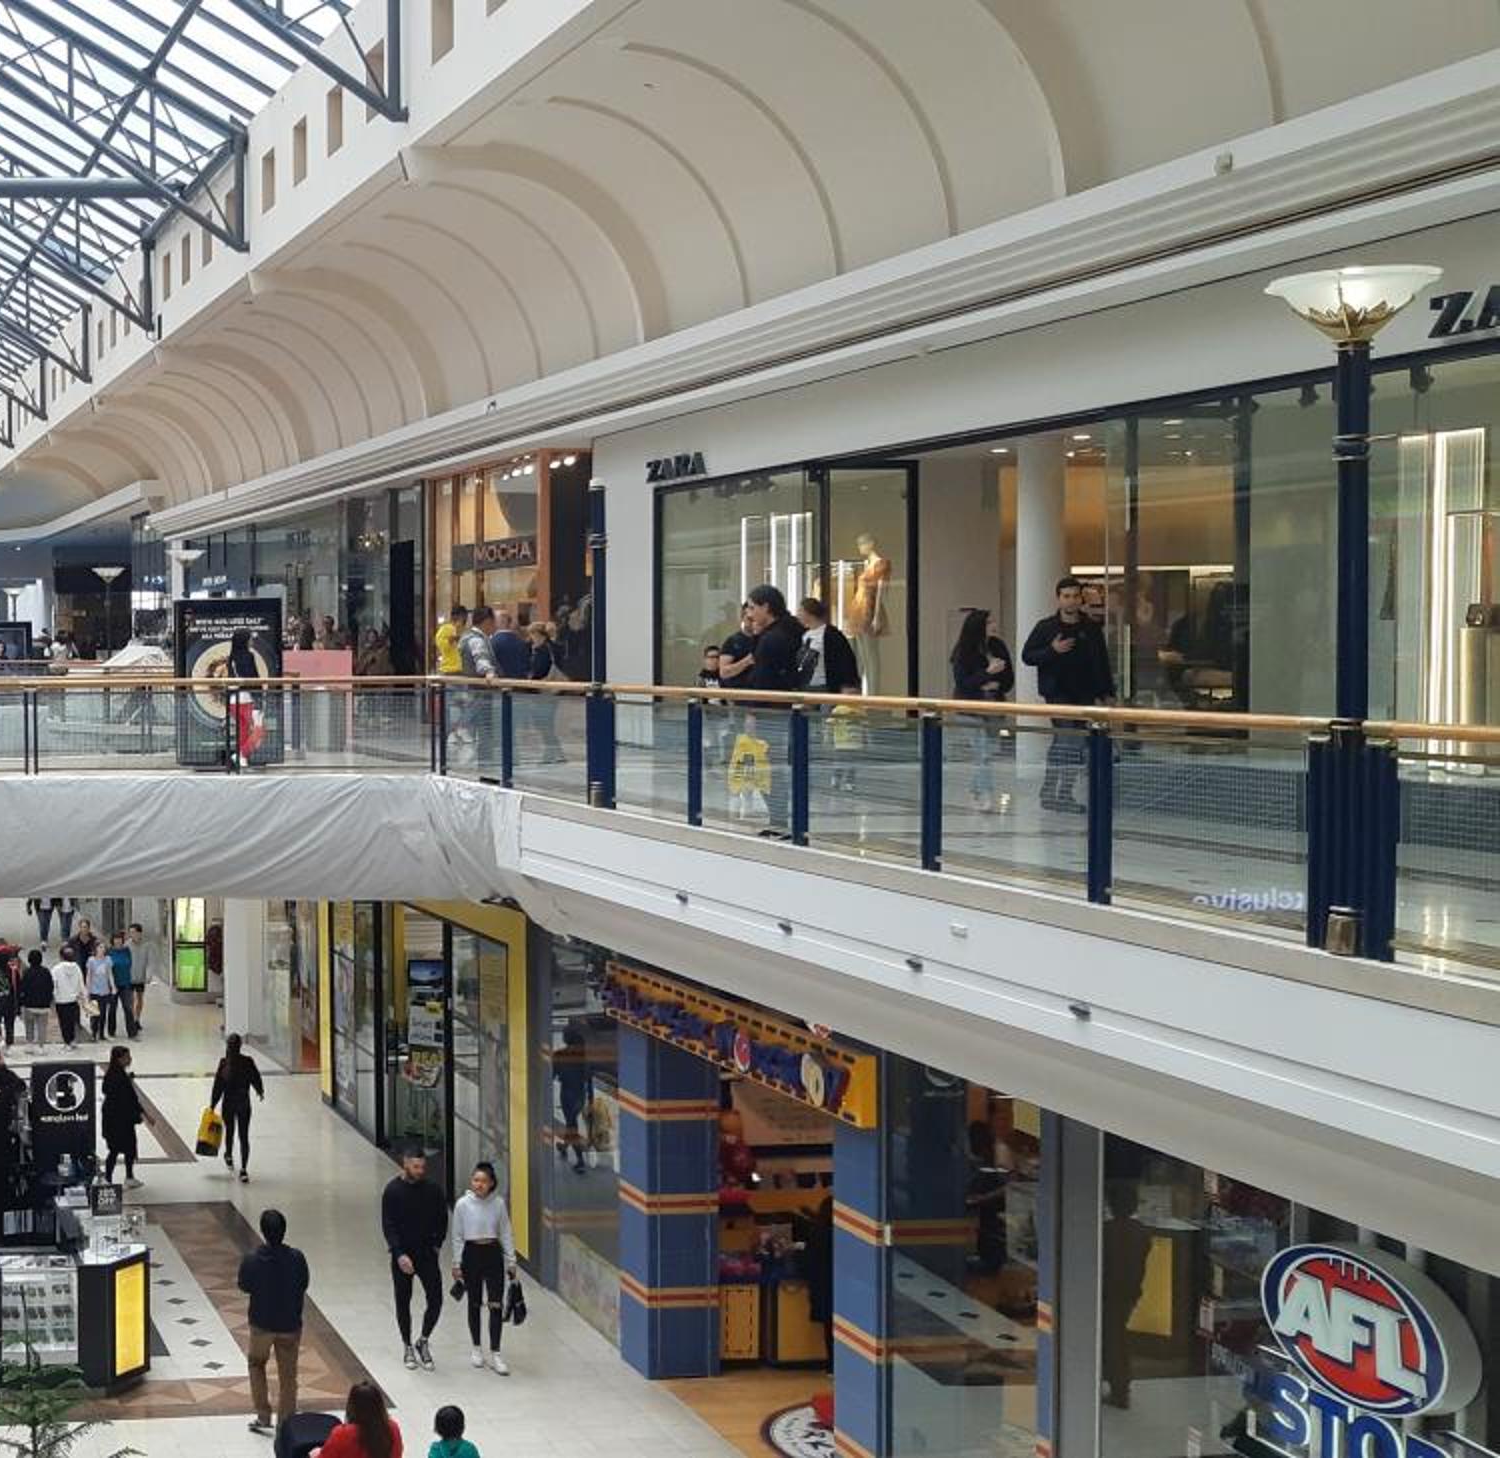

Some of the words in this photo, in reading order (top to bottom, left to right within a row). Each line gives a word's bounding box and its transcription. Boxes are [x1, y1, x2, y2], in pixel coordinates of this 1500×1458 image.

[646, 452, 707, 483] ZARA
[474, 541, 531, 562] MOCHA
[1273, 1272, 1428, 1402] AFL
